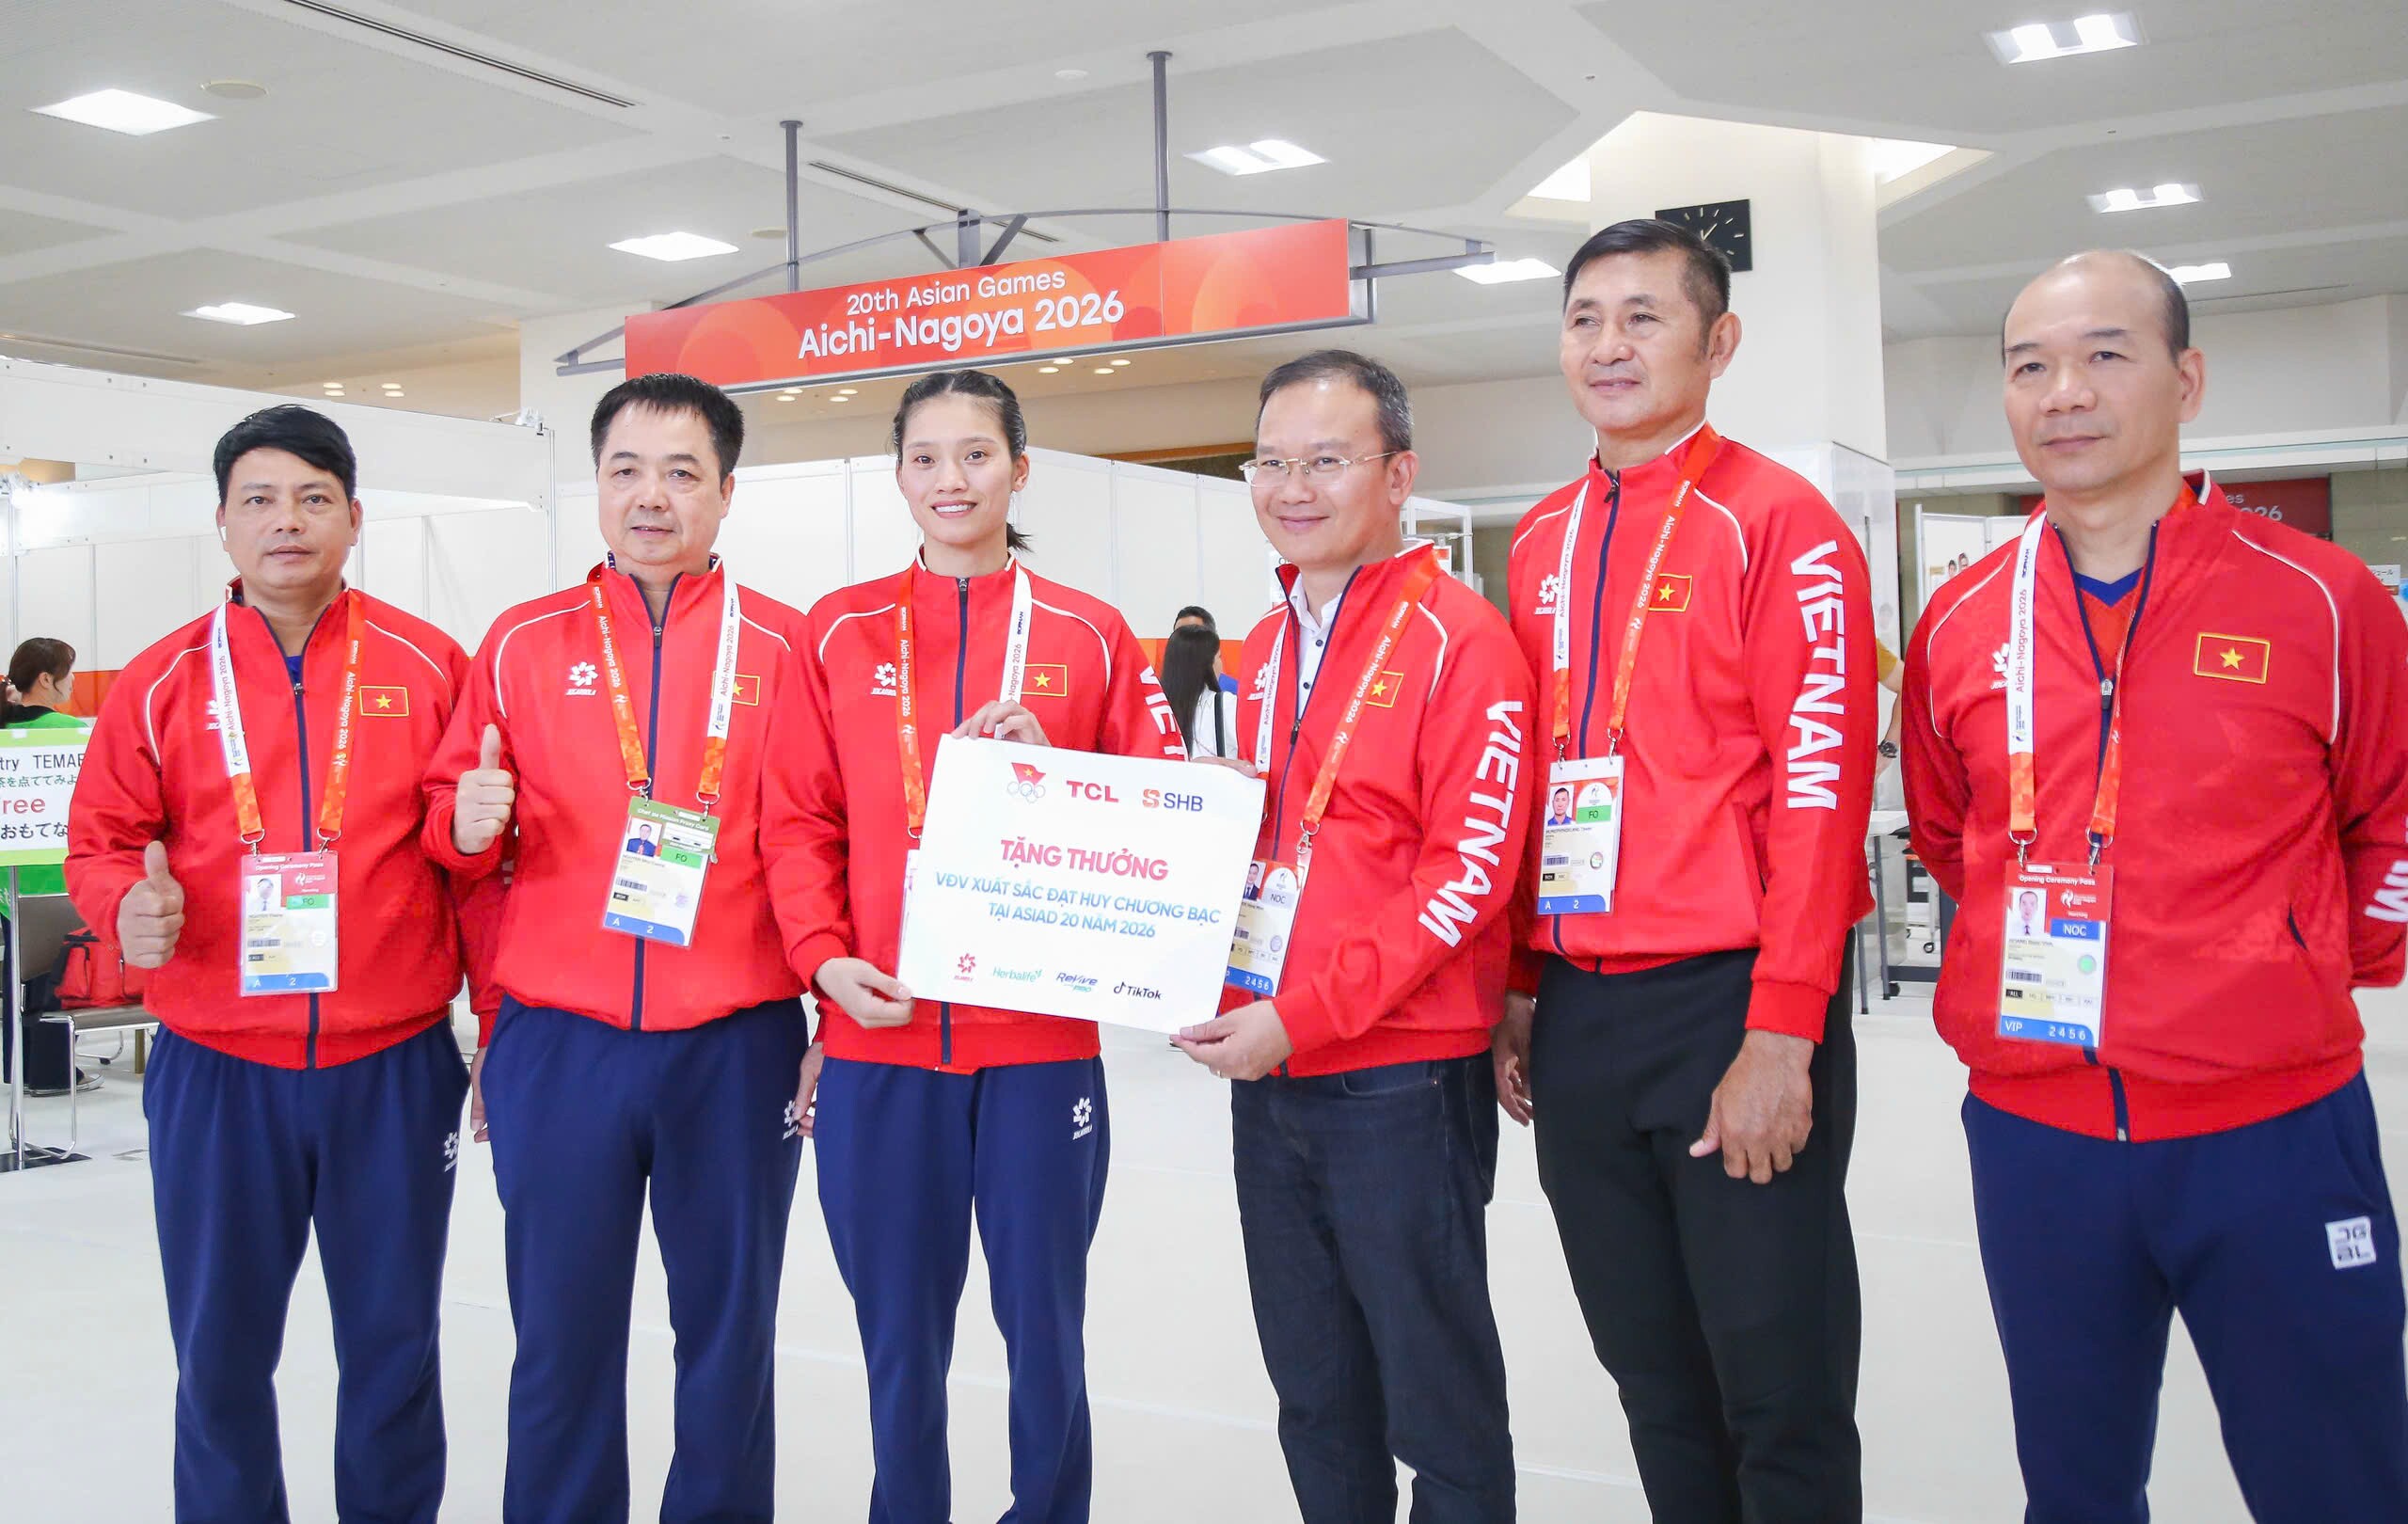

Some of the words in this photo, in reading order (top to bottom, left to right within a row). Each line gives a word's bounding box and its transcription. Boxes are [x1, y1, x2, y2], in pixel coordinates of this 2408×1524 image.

[847, 289, 899, 316] 20th
[906, 280, 971, 309] Asian
[977, 270, 1067, 297] Games
[799, 306, 1025, 359] Aichi-Nagoya
[1035, 290, 1125, 331] 2026
[2019, 589, 2027, 616] 2026
[2015, 619, 2029, 693] Aichi-Nagoya
[1787, 540, 1846, 811] VIETNAM
[1139, 665, 1189, 762] VIET
[1067, 780, 1119, 803] TCL
[1164, 792, 1204, 813] SHB
[3, 798, 46, 815] ree
[1418, 701, 1523, 948] VIETNAM
[675, 853, 688, 863] FO
[1001, 836, 1062, 869] TẶNG
[1068, 848, 1169, 881] THƯỞNG
[936, 870, 969, 889] VĐV
[1046, 888, 1079, 908] ĐẠT
[1080, 892, 1112, 909] HUY
[1187, 907, 1222, 927] BẠC
[612, 917, 620, 927] A
[646, 925, 655, 934] 2
[989, 902, 1011, 922] TẠI
[1012, 905, 1058, 925] ASIAD
[1060, 912, 1080, 928] 20
[1119, 920, 1156, 938] 2026
[2064, 924, 2087, 936] NOC
[992, 967, 1037, 984] Herbalife
[1126, 985, 1162, 1000] TikTok
[2004, 1021, 2023, 1032] VIP
